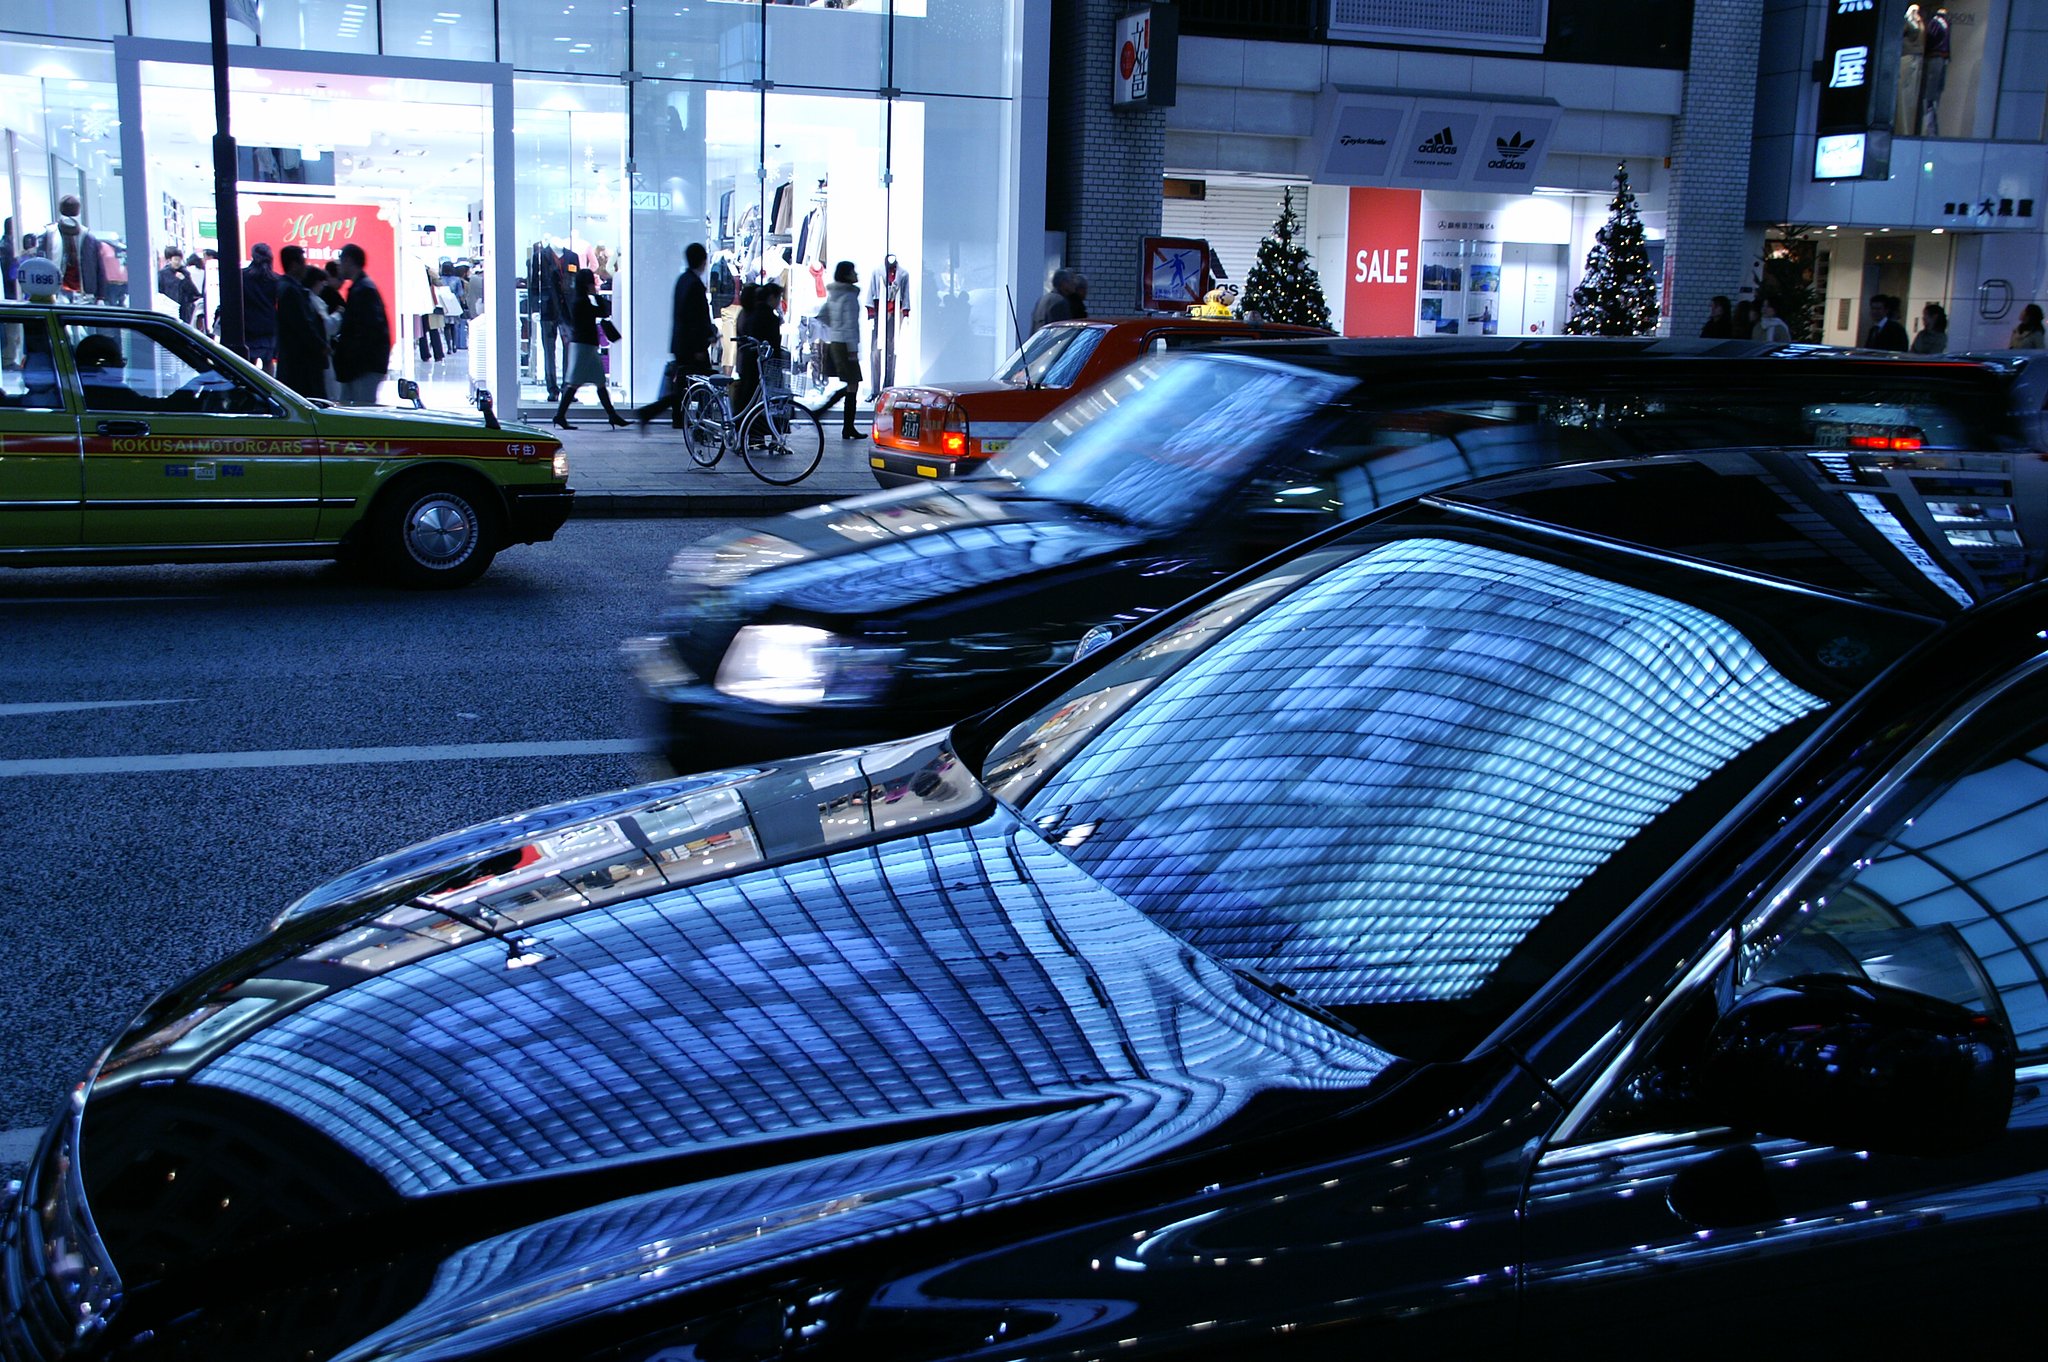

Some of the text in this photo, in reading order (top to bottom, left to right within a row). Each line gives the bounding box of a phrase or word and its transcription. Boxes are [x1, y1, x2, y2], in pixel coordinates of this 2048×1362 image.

[1340, 135, 1387, 146] TaylorMade
[1418, 143, 1458, 155] adidas
[1488, 158, 1526, 170] adidas
[283, 213, 357, 244] Happy
[303, 245, 345, 261] inte
[1355, 248, 1409, 283] SALE
[112, 439, 390, 453] KOKUSAI MOTORCARS TAXI
